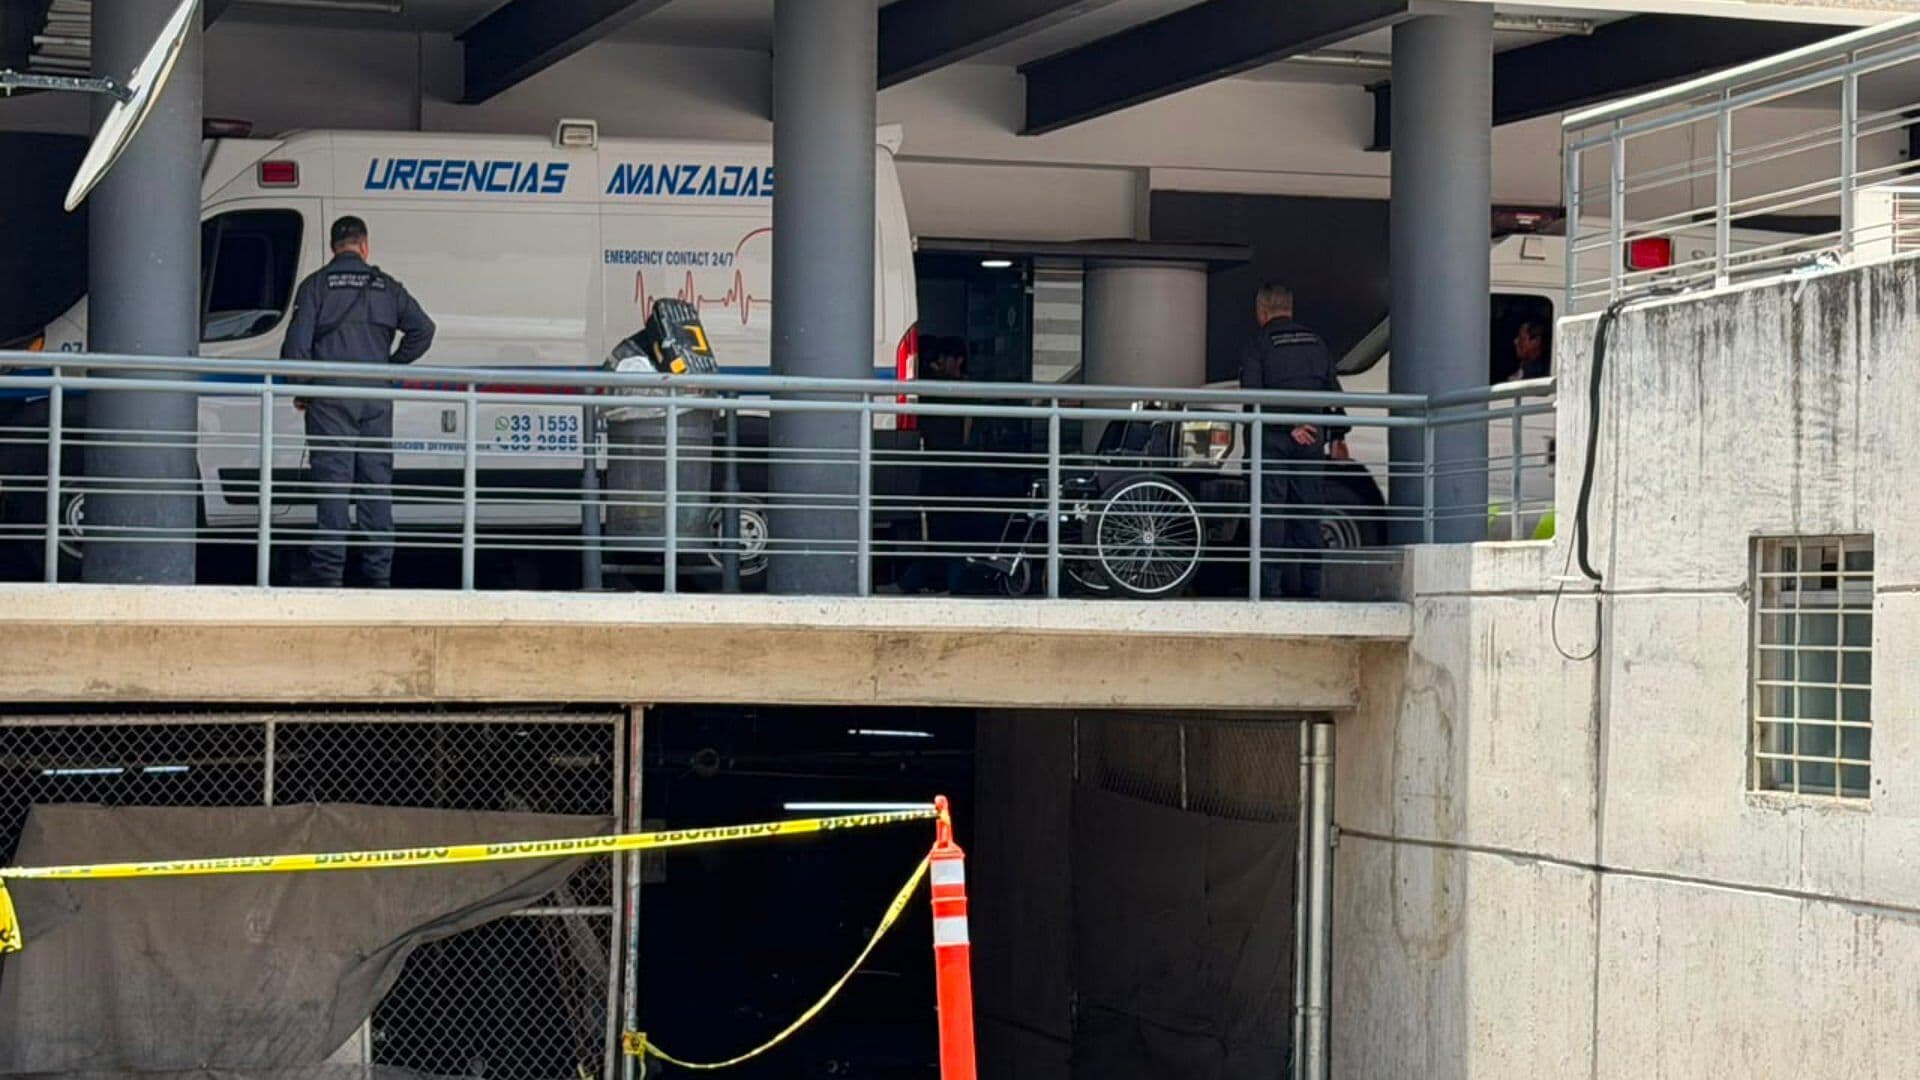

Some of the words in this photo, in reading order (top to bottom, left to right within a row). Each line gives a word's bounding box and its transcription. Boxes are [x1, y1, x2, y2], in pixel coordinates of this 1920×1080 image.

[364, 158, 570, 194] URGENCIAS
[605, 163, 774, 197] AVANZADAS
[604, 250, 662, 265] EMERGENCY
[666, 251, 708, 266] CONTACT
[712, 252, 734, 267] 24/7
[511, 415, 531, 432] 33
[538, 415, 578, 432] 1553
